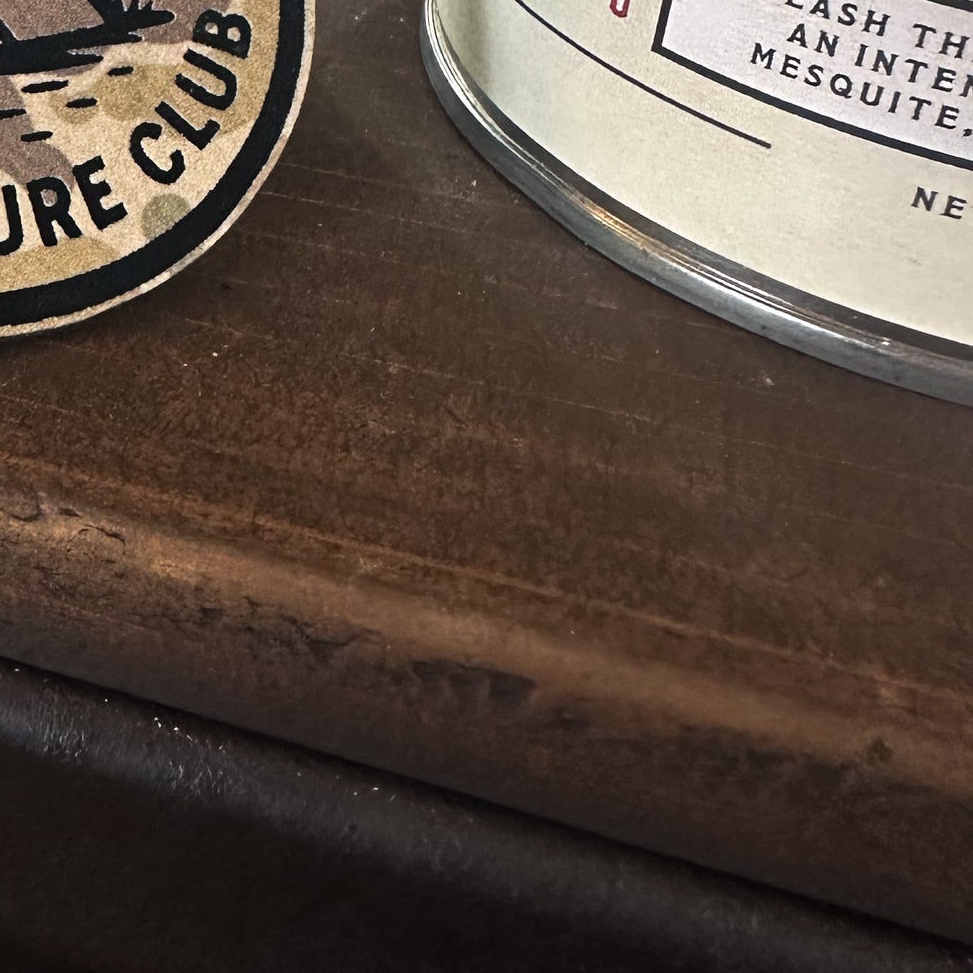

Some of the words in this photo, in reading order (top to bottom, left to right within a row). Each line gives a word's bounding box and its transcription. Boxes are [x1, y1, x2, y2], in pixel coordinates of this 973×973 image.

[787, 23, 840, 58] AN
[912, 23, 973, 60] TH
[129, 7, 253, 185] CLUB
[750, 41, 973, 137] MESQUITE,
[910, 185, 973, 220] NE
